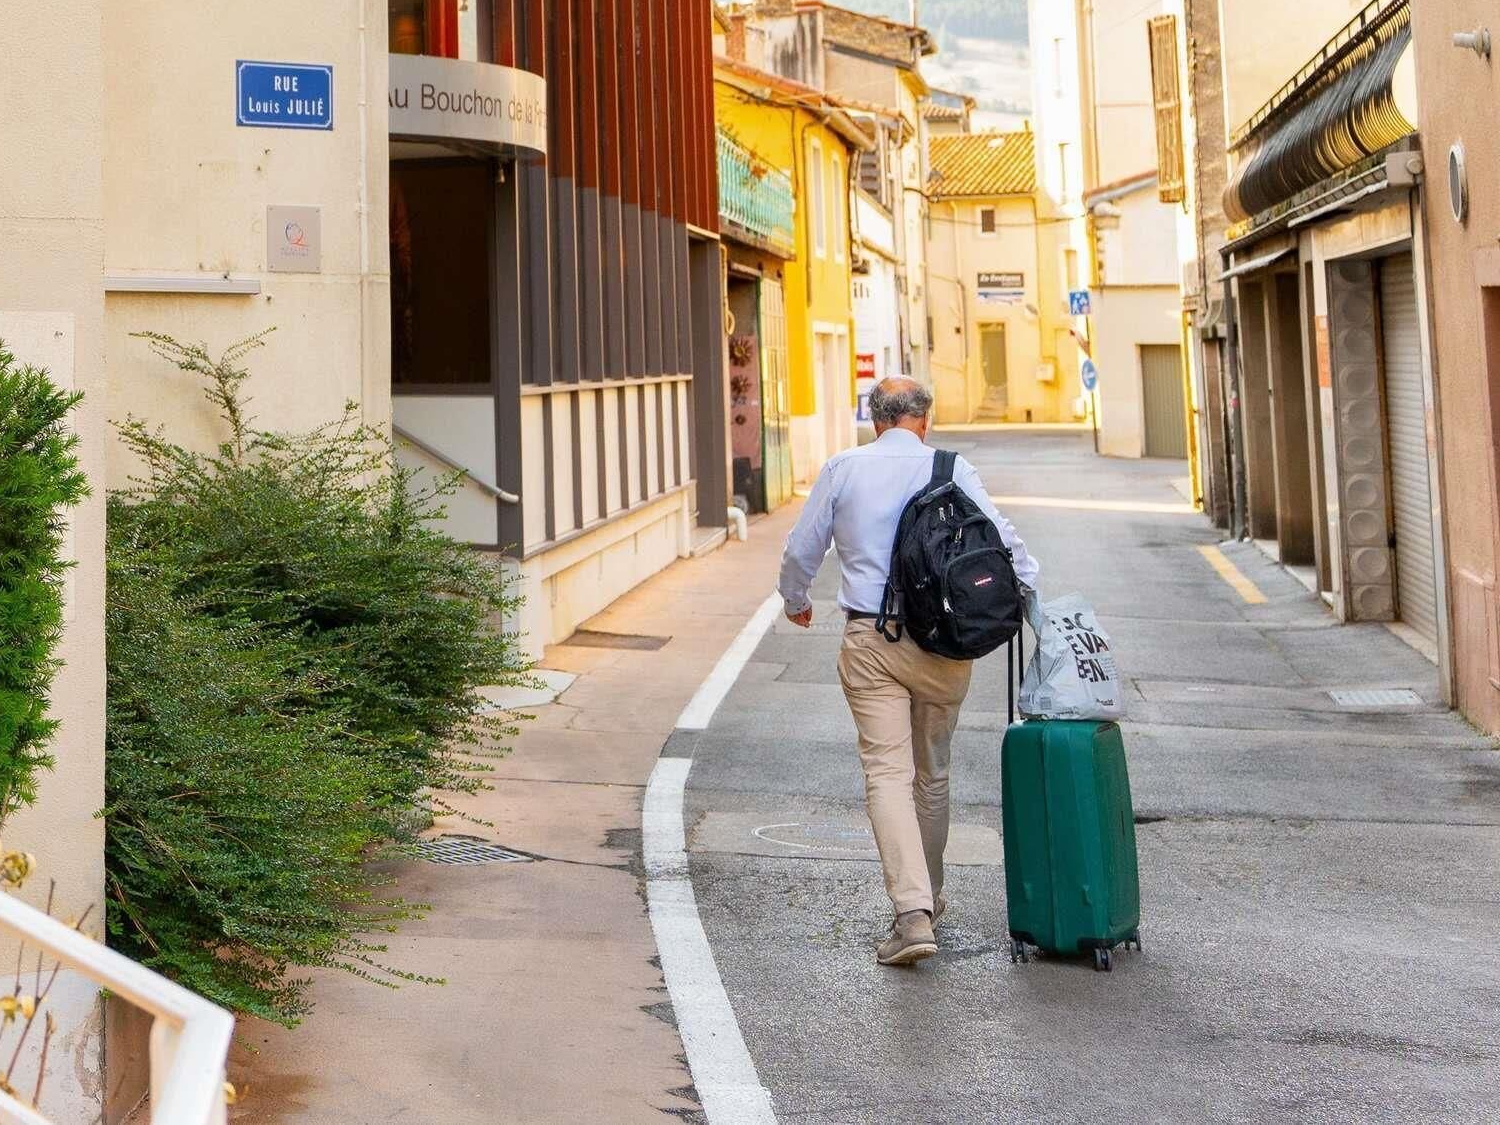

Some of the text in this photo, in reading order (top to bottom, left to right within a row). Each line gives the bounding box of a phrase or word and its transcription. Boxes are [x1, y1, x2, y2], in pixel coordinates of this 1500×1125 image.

[274, 75, 299, 92] RUE
[248, 96, 324, 116] Louis JULIÉ
[388, 87, 408, 109] u
[420, 83, 502, 119] Bouchon
[507, 94, 522, 122] de
